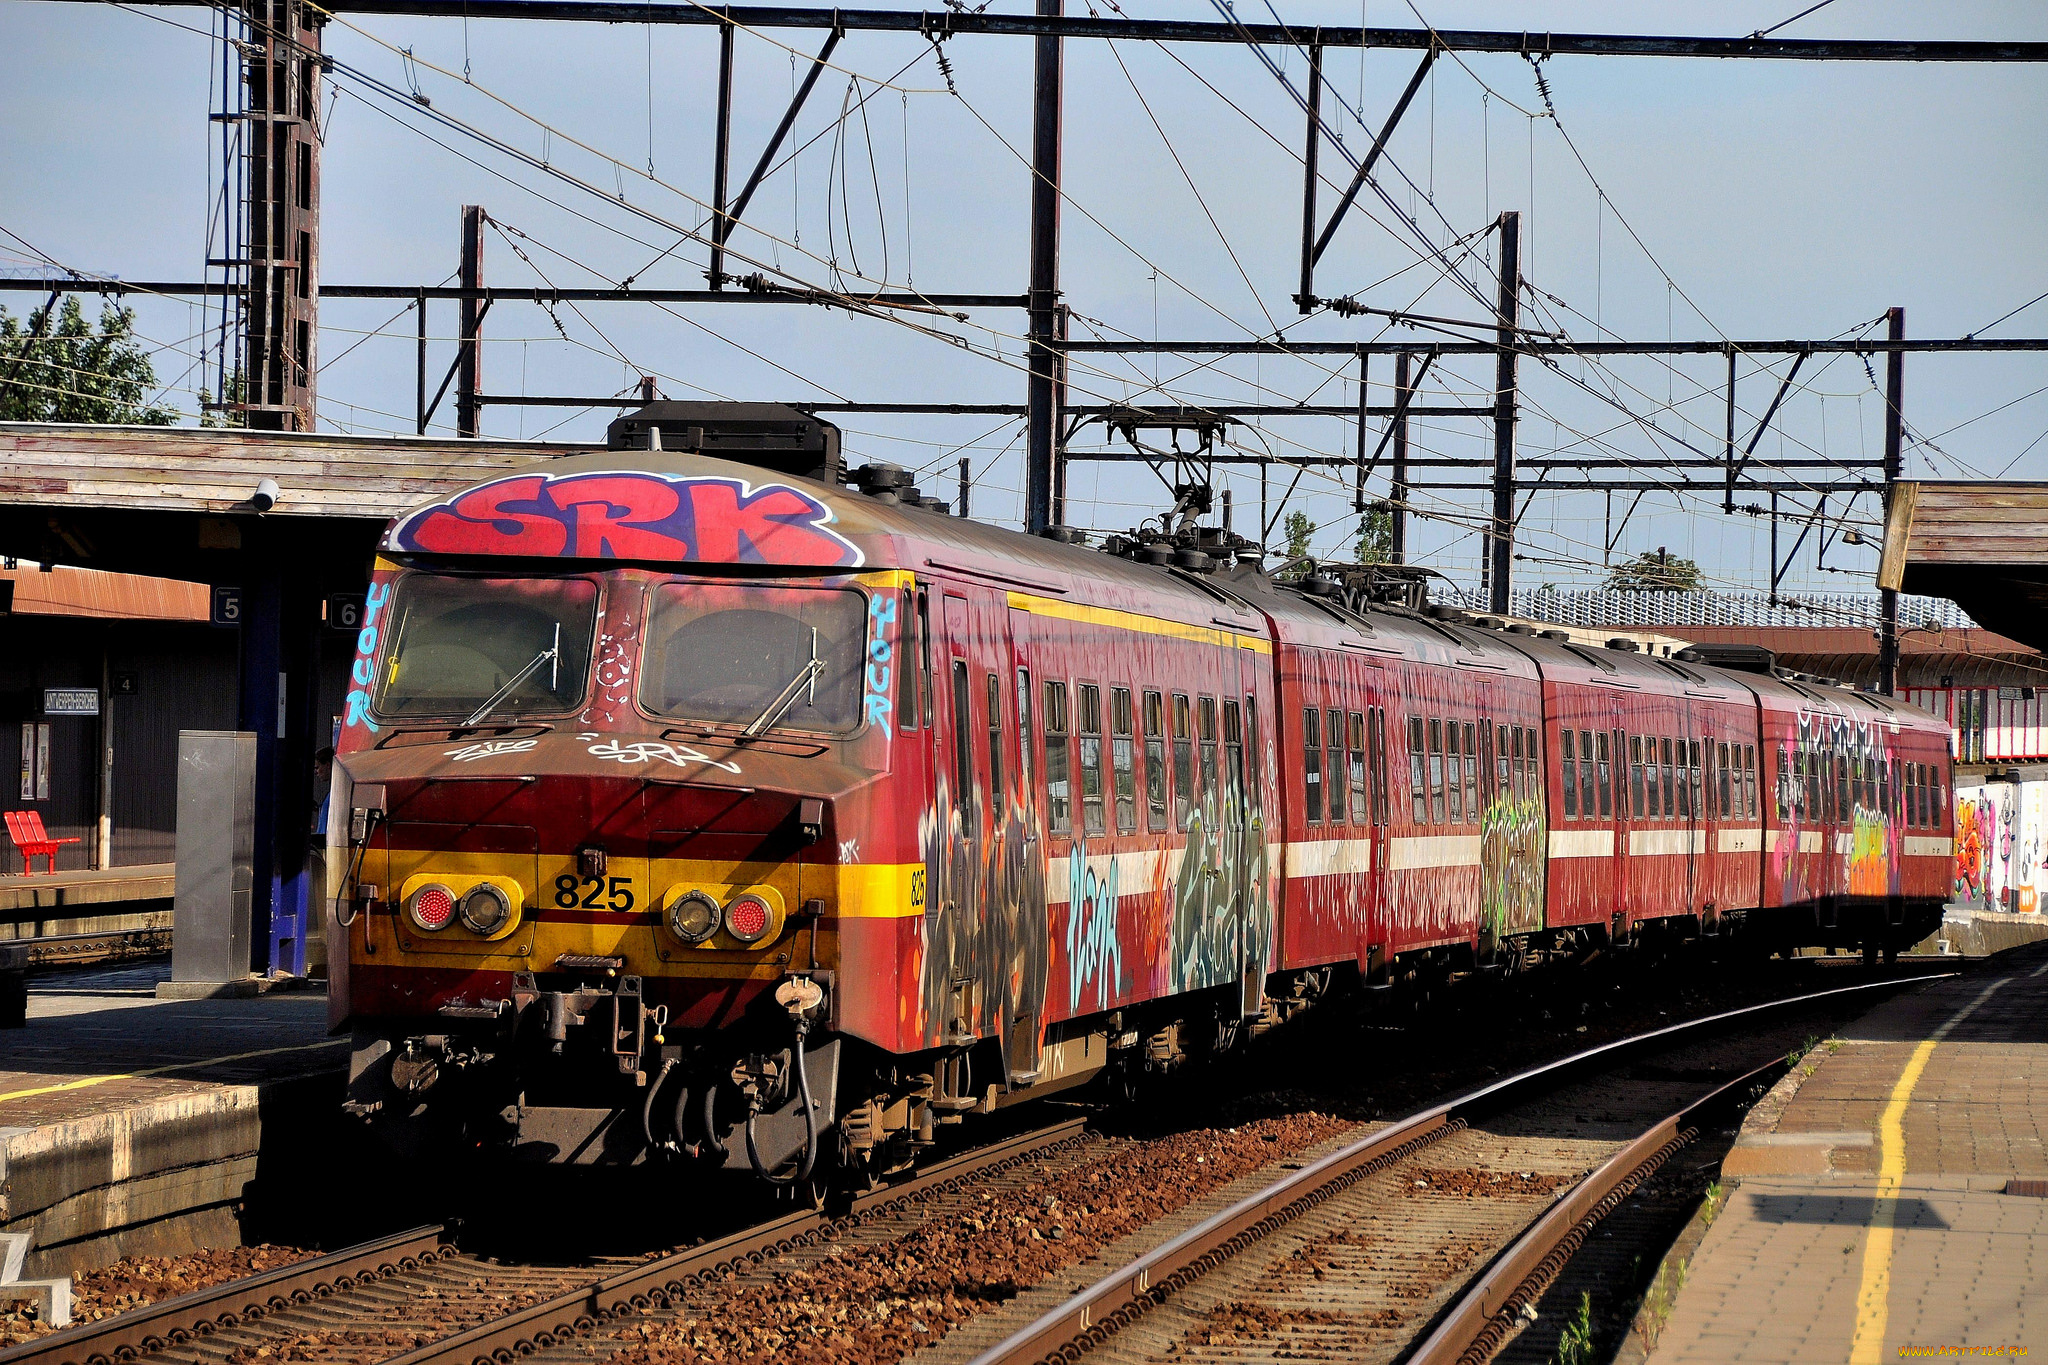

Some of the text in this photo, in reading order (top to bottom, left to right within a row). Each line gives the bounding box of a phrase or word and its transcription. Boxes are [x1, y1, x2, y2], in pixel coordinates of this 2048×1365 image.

[400, 472, 857, 568] SRK
[224, 598, 239, 619] 5
[341, 603, 356, 625] 6
[346, 581, 391, 733] YOUR
[865, 593, 897, 741] YOUR
[121, 679, 131, 691] 4
[554, 874, 635, 913] 825
[911, 869, 925, 907] 825
